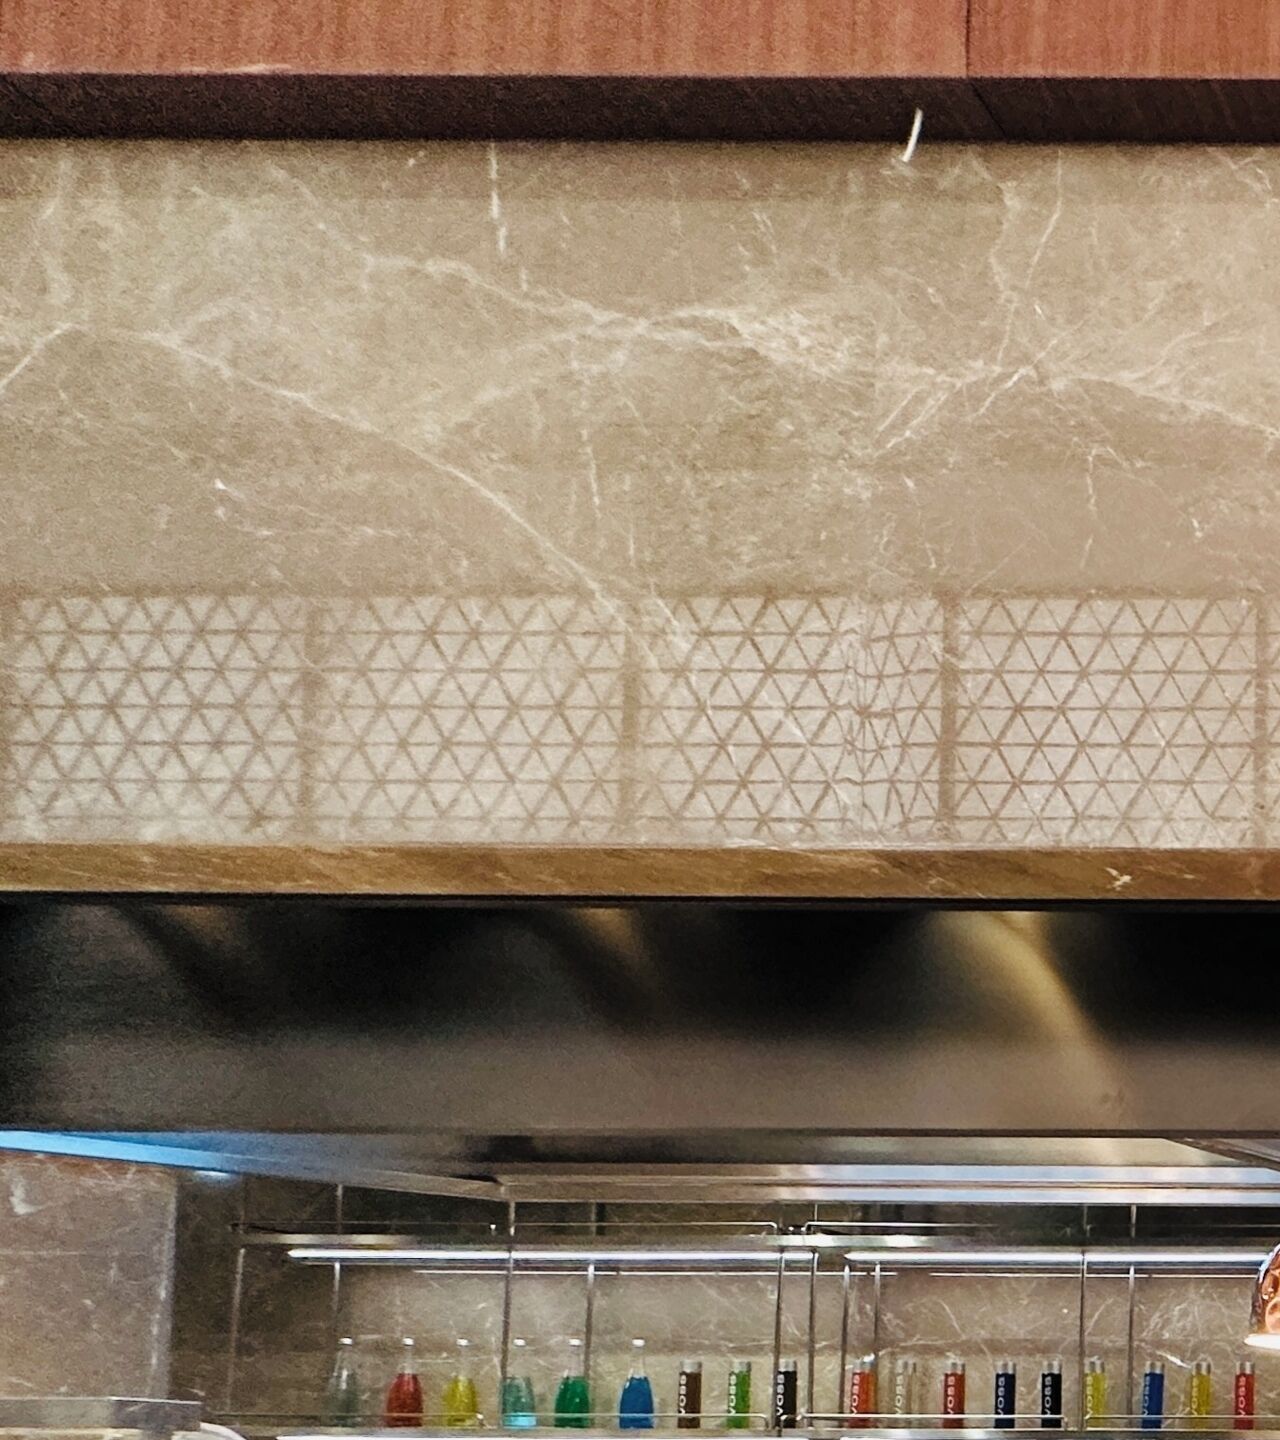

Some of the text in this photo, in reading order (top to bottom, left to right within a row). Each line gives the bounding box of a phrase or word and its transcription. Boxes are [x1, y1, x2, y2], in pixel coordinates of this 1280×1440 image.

[679, 1374, 687, 1415] VOSS
[728, 1374, 737, 1415] VOSS
[776, 1374, 786, 1416] VOSS
[851, 1374, 861, 1415] VOSS
[947, 1376, 955, 1415] VOSS
[997, 1377, 1006, 1415] VOSS
[1044, 1377, 1053, 1415] VOSS
[1238, 1376, 1246, 1416] VOSS
